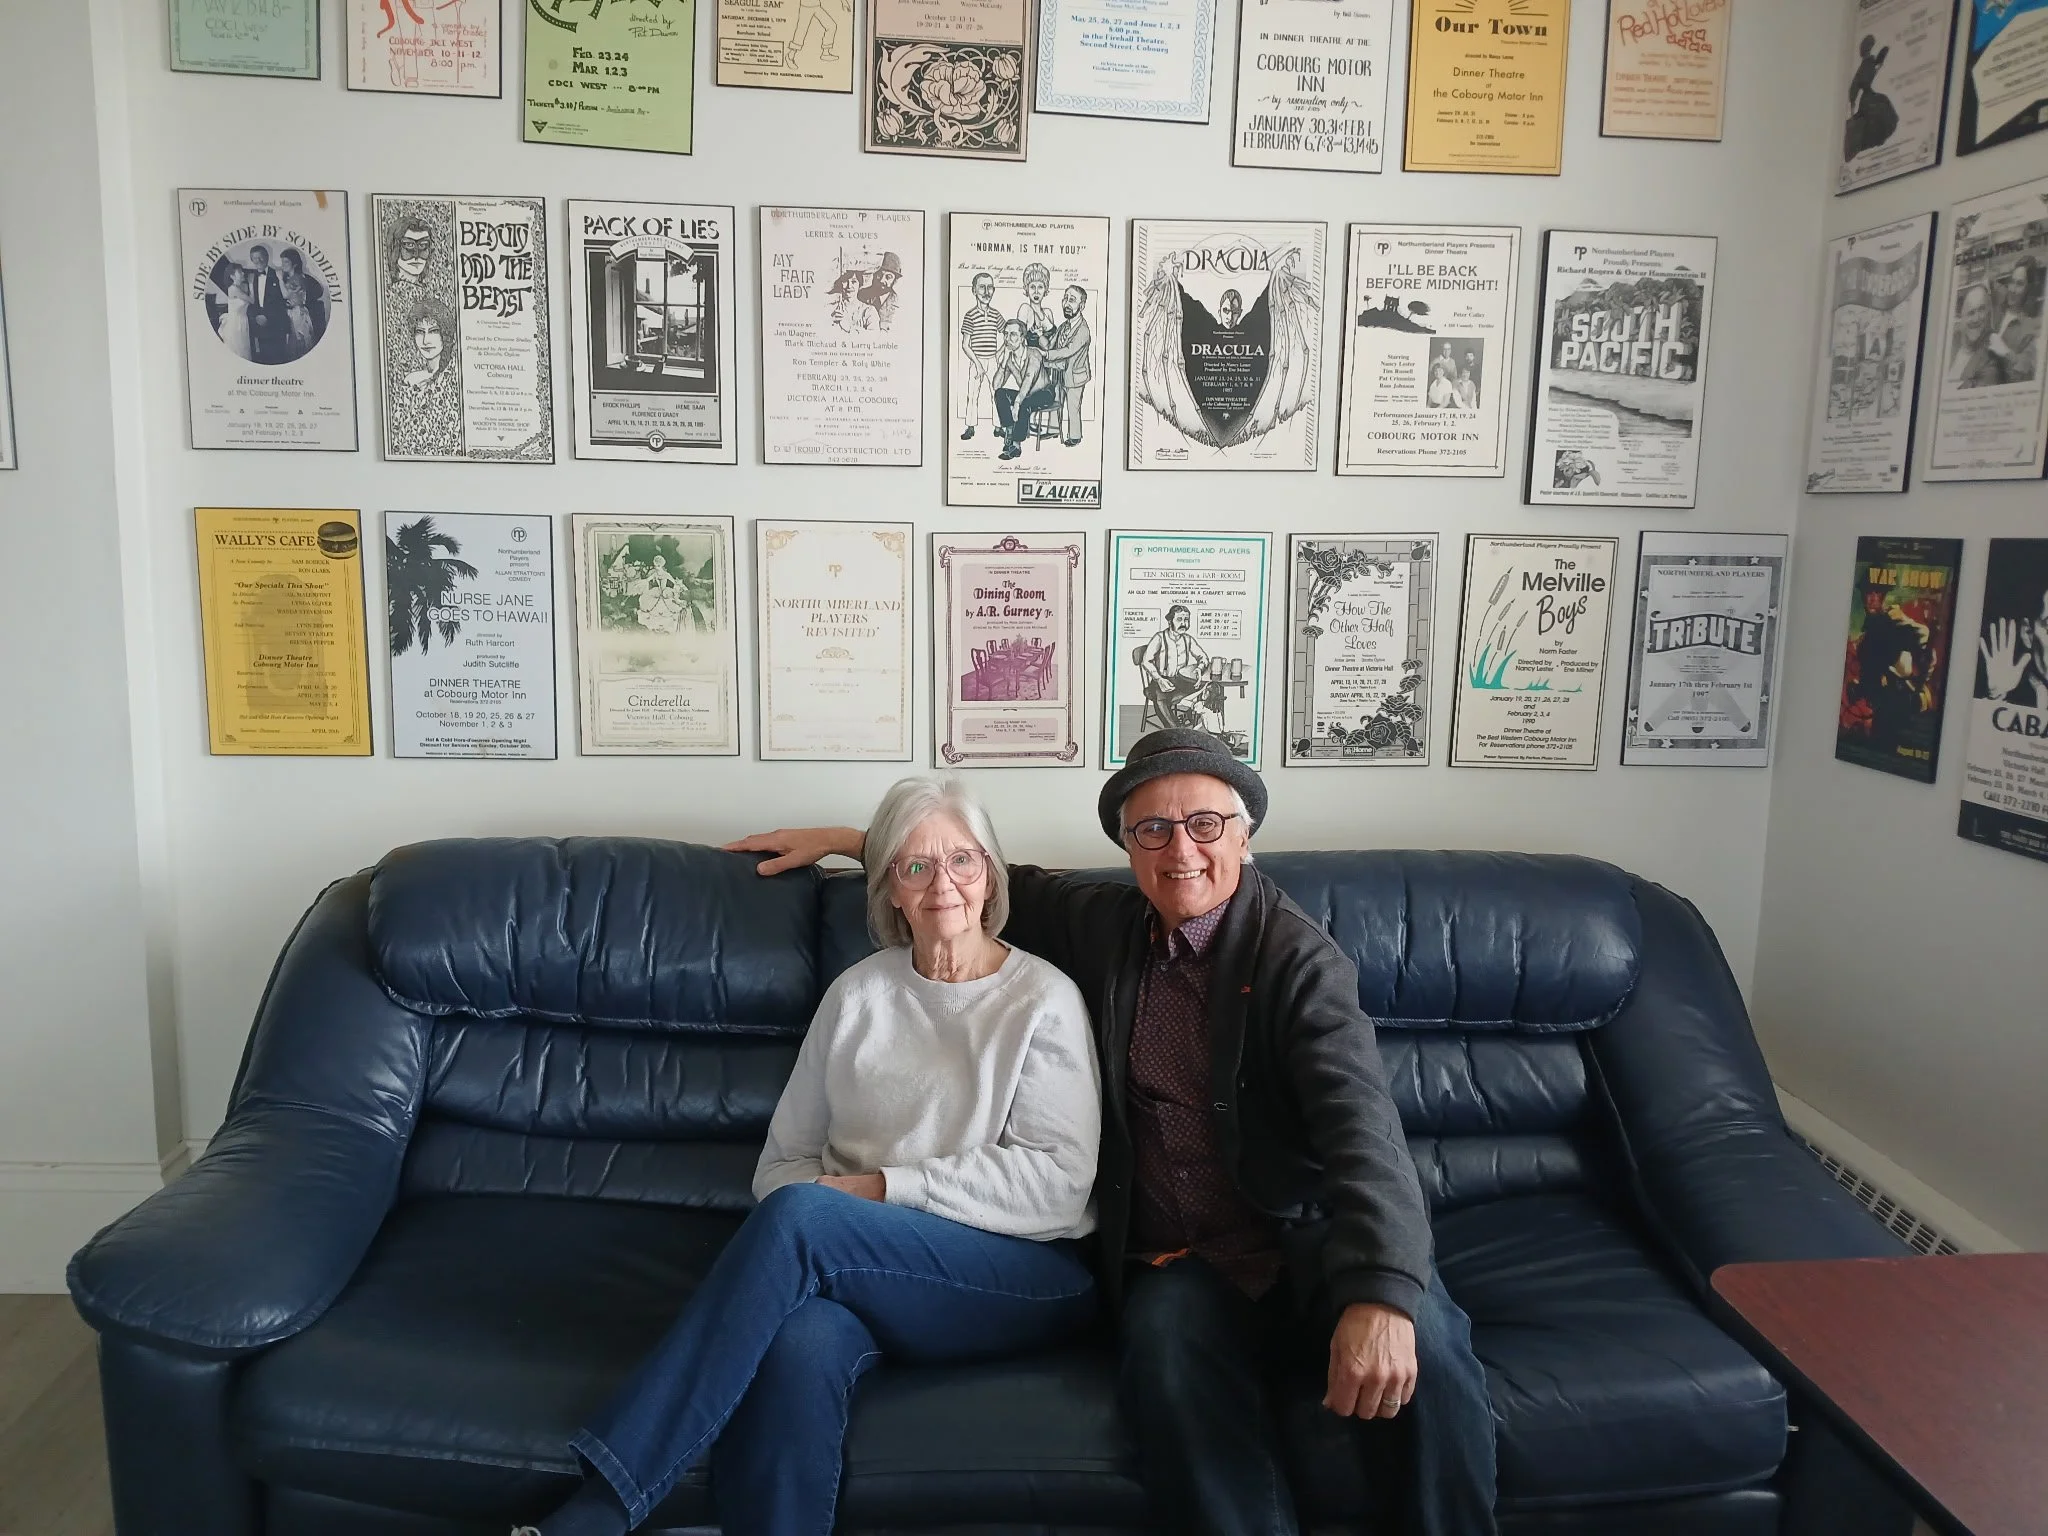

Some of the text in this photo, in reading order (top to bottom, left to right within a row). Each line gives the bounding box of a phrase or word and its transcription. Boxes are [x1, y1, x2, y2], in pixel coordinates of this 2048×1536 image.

[1435, 16, 1547, 36] Our Town
[1617, 11, 1655, 46] Red
[449, 40, 473, 48] WEST
[1274, 34, 1304, 42] DINNER
[1310, 36, 1341, 44] THEATRE
[1080, 41, 1107, 49] Second
[1136, 45, 1169, 54] Cobourg
[1257, 54, 1371, 76] COBOURG MOTOR
[1453, 67, 1524, 79] Dinner Theatre
[580, 82, 607, 90] WEST
[1297, 75, 1325, 92] INN
[1433, 88, 1543, 101] the Cobourg Motor Inn
[1249, 115, 1305, 133] JANUARY
[1243, 132, 1302, 150] FEBRUARY
[584, 215, 719, 239] PACK OF LIES
[460, 221, 529, 253] BEAUTY
[1020, 244, 1028, 253] IS
[1034, 245, 1054, 254] THAT
[1592, 248, 1648, 257] Northumberland
[1650, 250, 1675, 258] Players
[193, 225, 343, 303] SIDE BY SIDE BY SONDHEIM
[773, 254, 794, 267] MY
[461, 252, 532, 284] AND THE
[1388, 264, 1478, 277] I'LL BE BACK
[1588, 268, 1614, 276] Rogers
[781, 270, 815, 283] FAIR
[1366, 278, 1498, 291] BEFORE MIDNIGHT!
[773, 285, 811, 299] LADY
[462, 285, 532, 318] BEAST
[1571, 303, 1682, 343] SOUTH
[1191, 344, 1264, 356] DRACULA
[1560, 341, 1684, 379] PACIFIC
[237, 376, 304, 386] dinner theatre
[250, 390, 279, 398] Cobourg
[1367, 432, 1416, 440] COBOURG
[1421, 432, 1457, 441] MOTOR
[1035, 485, 1098, 499] LAURIA
[214, 534, 315, 546] WALLY'S CAFE
[1554, 559, 1576, 570] The
[255, 582, 284, 590] Specials
[1002, 580, 1016, 589] The
[1522, 572, 1605, 592] Melville
[441, 592, 533, 607] NURSE JANE
[973, 588, 1046, 602] Dining Room
[773, 598, 900, 611] NORTHUMBERLAND
[1334, 601, 1391, 616] How The
[428, 609, 548, 623] GOES TO HAWAII
[811, 613, 868, 623] PLAYERS
[966, 608, 974, 618] by
[976, 605, 1000, 617] A.R.
[1003, 605, 1042, 619] Gurney
[1536, 595, 1588, 635] Boys
[1330, 618, 1394, 637] Other Half
[1345, 635, 1377, 650] Loves
[429, 679, 521, 688] DINNER THEATRE
[424, 690, 527, 700] at Cobourg Motor Inn
[628, 695, 690, 707] Cinderella
